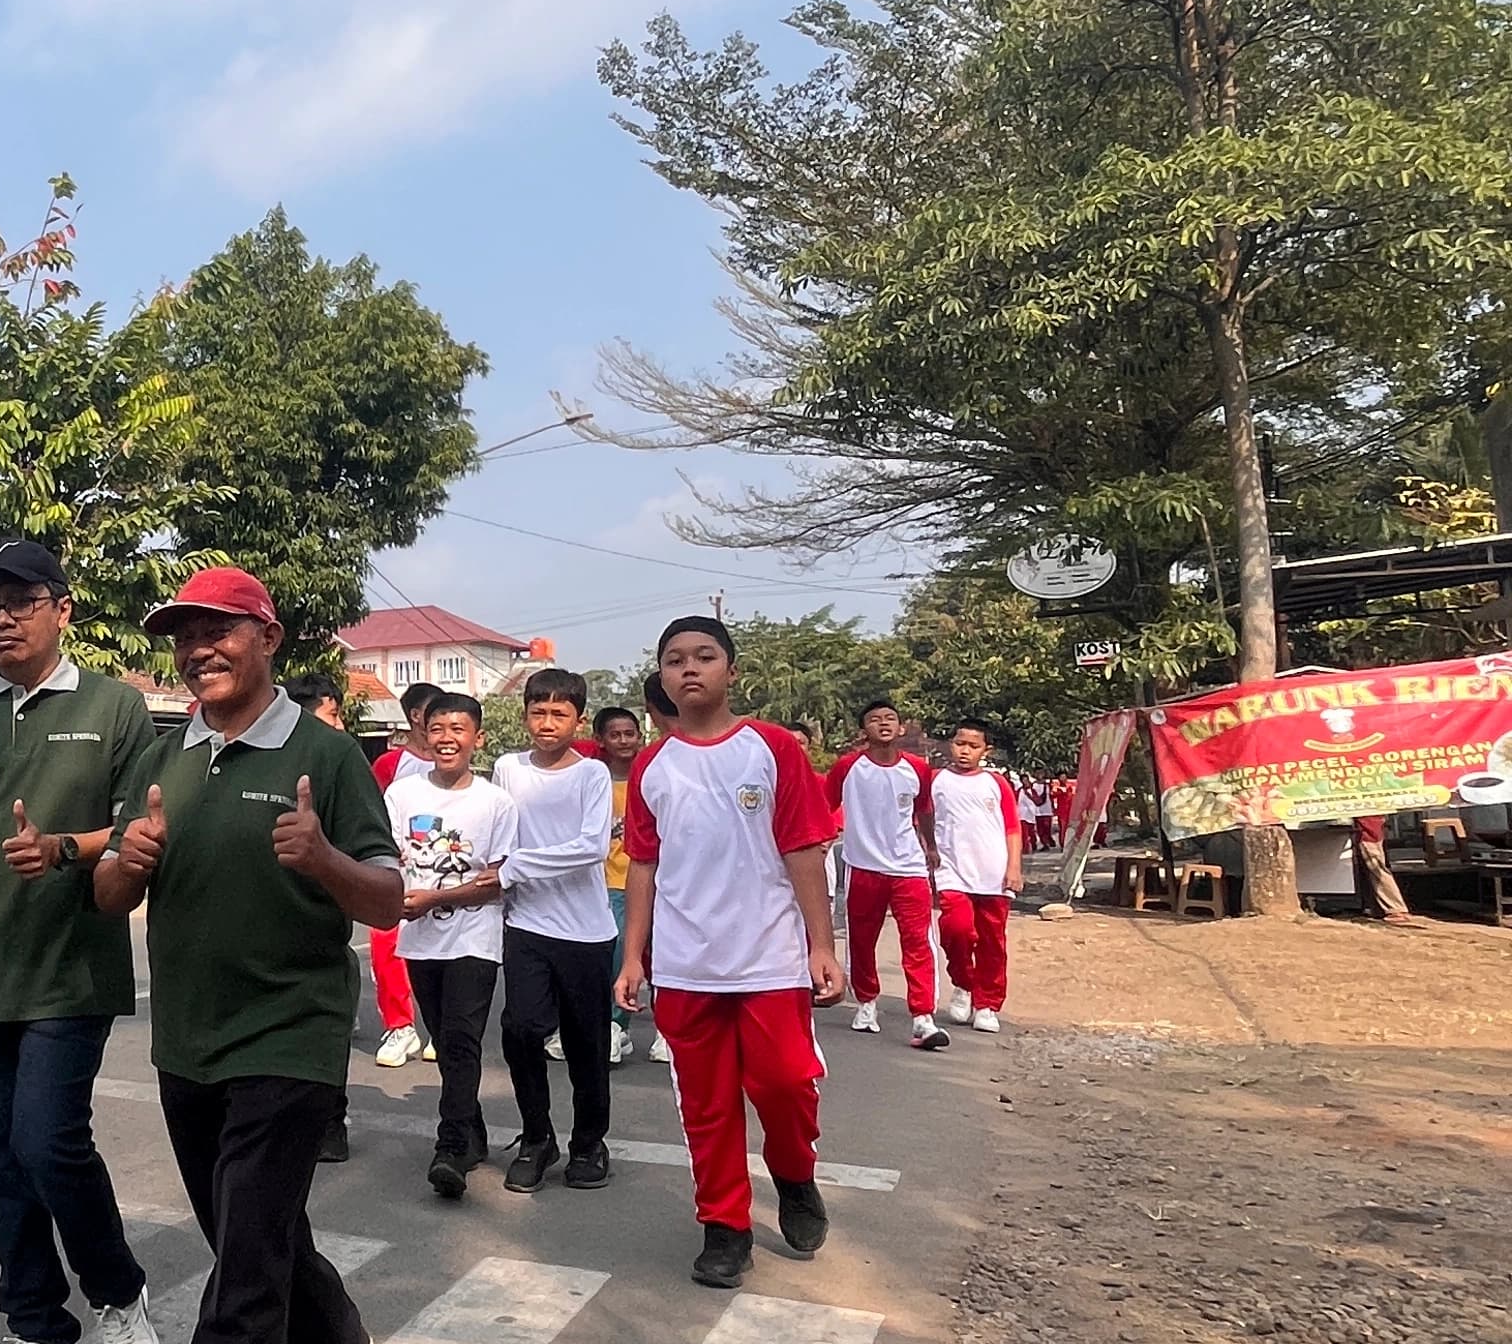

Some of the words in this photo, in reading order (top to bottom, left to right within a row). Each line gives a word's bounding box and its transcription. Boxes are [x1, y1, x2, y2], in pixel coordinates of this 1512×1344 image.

[1076, 641, 1120, 656] KOST
[1177, 680, 1384, 747] WARUNK
[1220, 763, 1280, 784] KUPAT
[1283, 755, 1353, 772] PECEL
[1368, 741, 1493, 764] GORENGAN
[1296, 762, 1409, 783] MENDOAN
[1411, 753, 1486, 772] SIRAM
[1328, 775, 1383, 791] KOPI
[1293, 795, 1358, 805] MENERIMA
[1362, 790, 1418, 799] PESANAN
